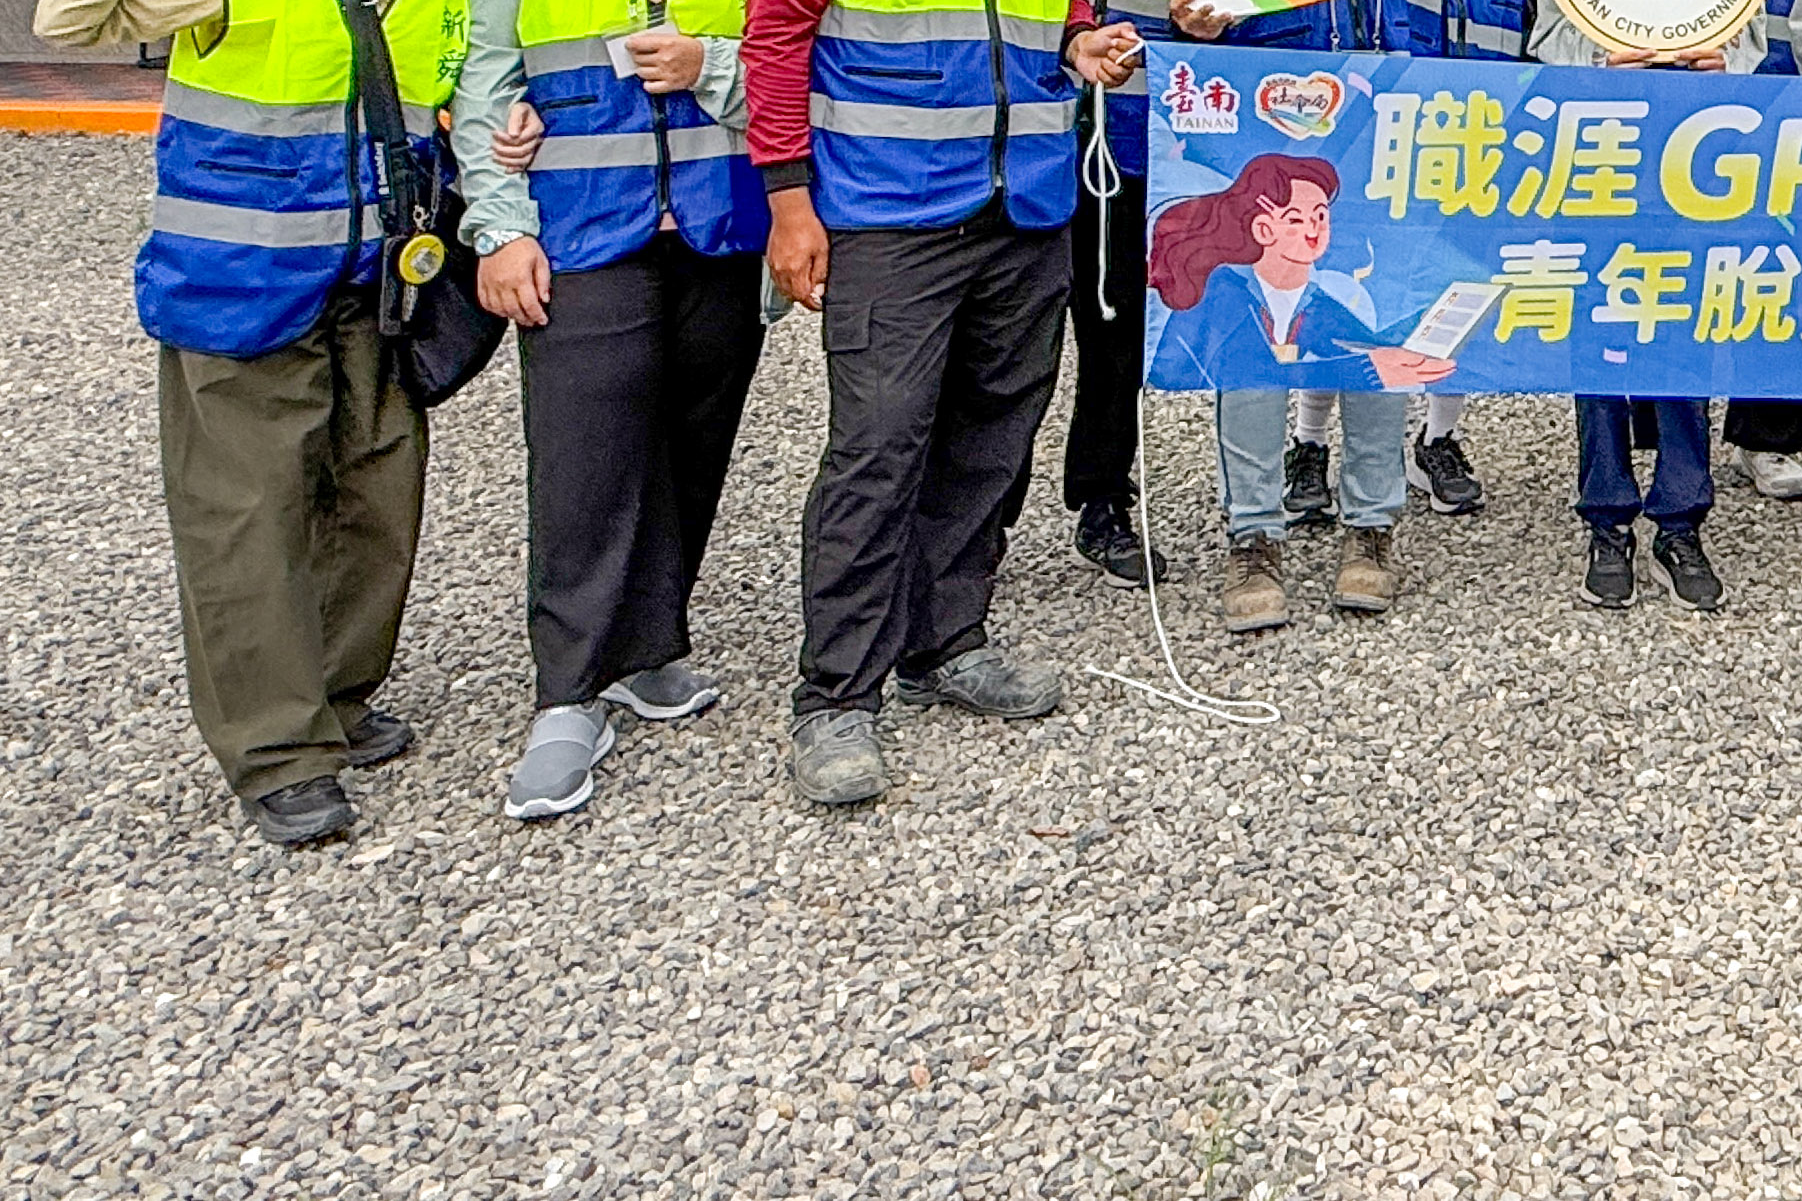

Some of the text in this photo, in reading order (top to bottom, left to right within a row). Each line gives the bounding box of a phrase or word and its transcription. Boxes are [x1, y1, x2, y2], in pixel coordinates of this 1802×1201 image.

[1614, 16, 1655, 38] CITY
[436, 4, 466, 86] 新舜
[1166, 65, 1235, 113] 臺南
[1175, 116, 1235, 129] TAINAN
